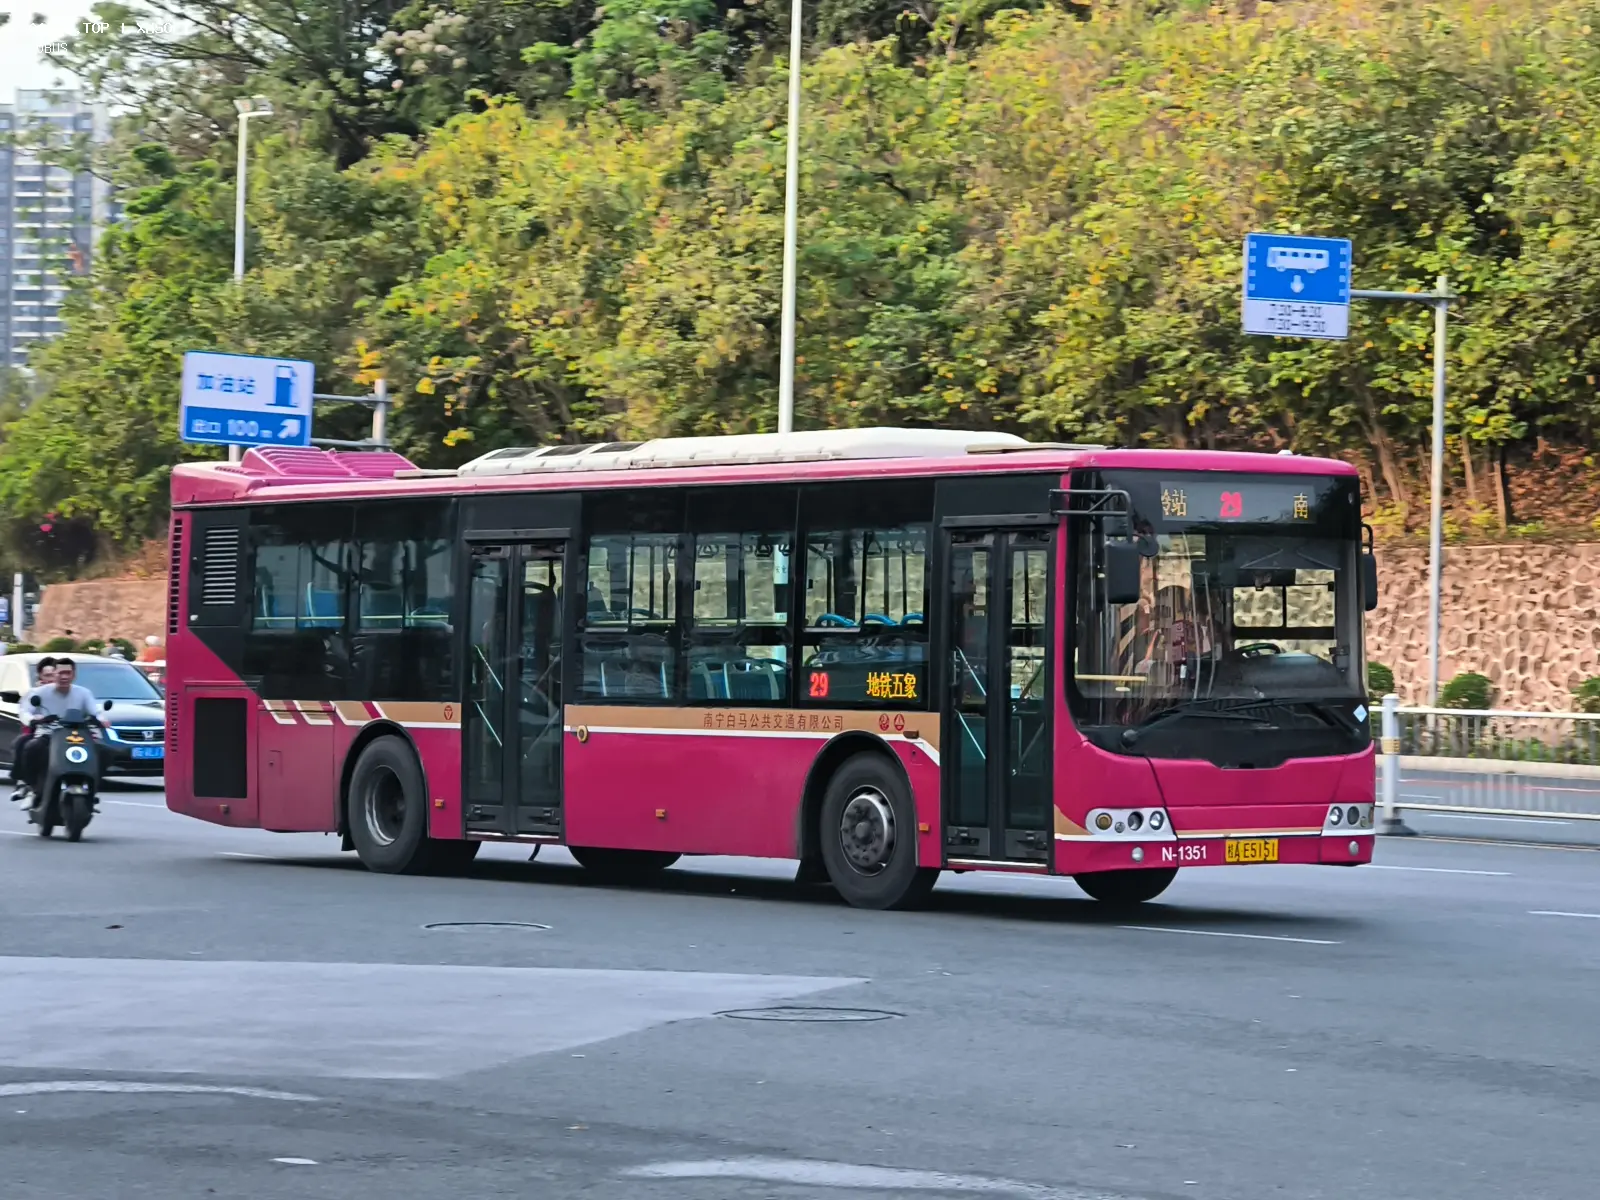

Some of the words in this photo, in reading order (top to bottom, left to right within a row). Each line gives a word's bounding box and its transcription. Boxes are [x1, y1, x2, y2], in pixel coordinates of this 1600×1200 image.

[1220, 491, 1243, 518] 29
[1293, 492, 1309, 519] 南
[809, 671, 829, 698] 29
[866, 671, 918, 699] 地铁五象
[703, 712, 844, 730] 南宁白马公共交通有限公司
[1161, 845, 1207, 861] N-1351
